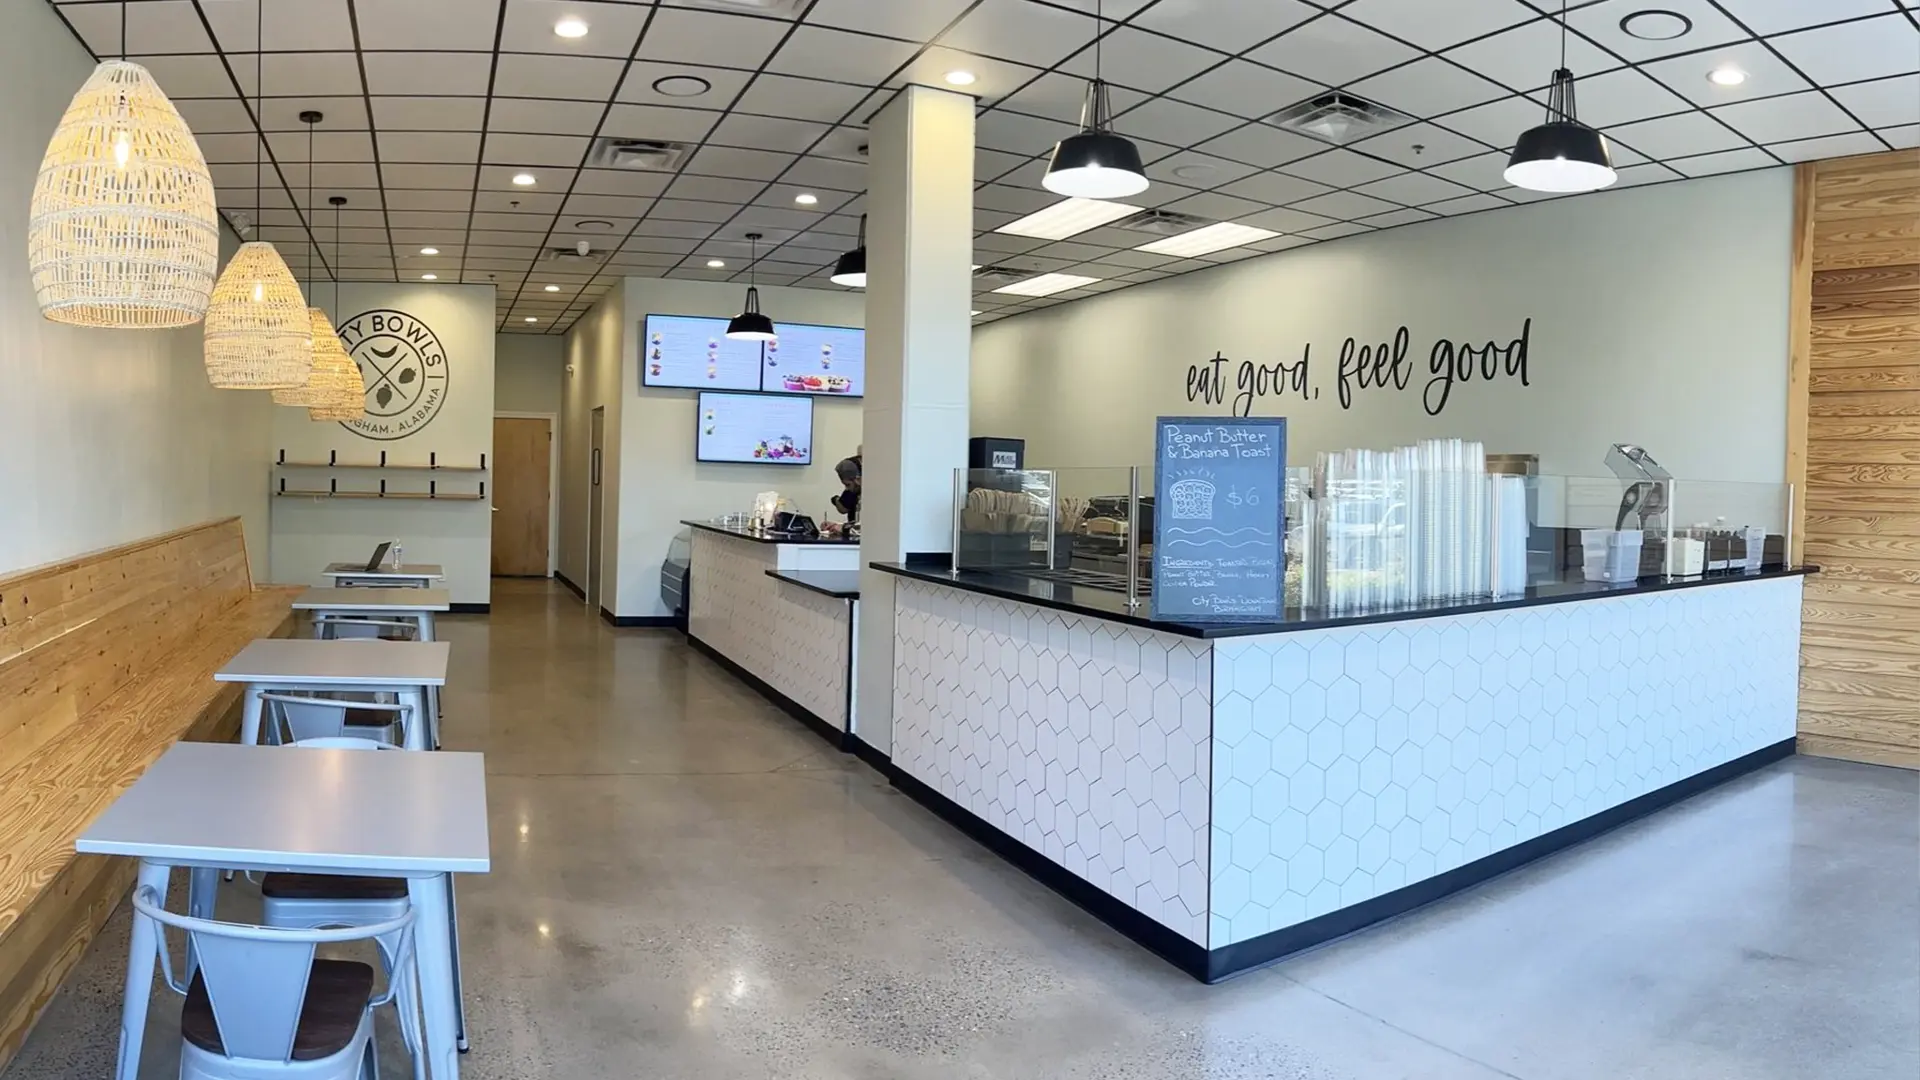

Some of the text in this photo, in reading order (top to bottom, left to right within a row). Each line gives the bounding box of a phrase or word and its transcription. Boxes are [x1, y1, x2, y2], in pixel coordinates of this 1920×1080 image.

[339, 315, 442, 367] TY BOWLS
[1187, 318, 1531, 417] eat good, feel good
[398, 387, 440, 432] ALABAMA
[1164, 424, 1267, 443] Peanut Butter
[1167, 443, 1272, 459] & Banana Toast
[1226, 484, 1260, 509] $6
